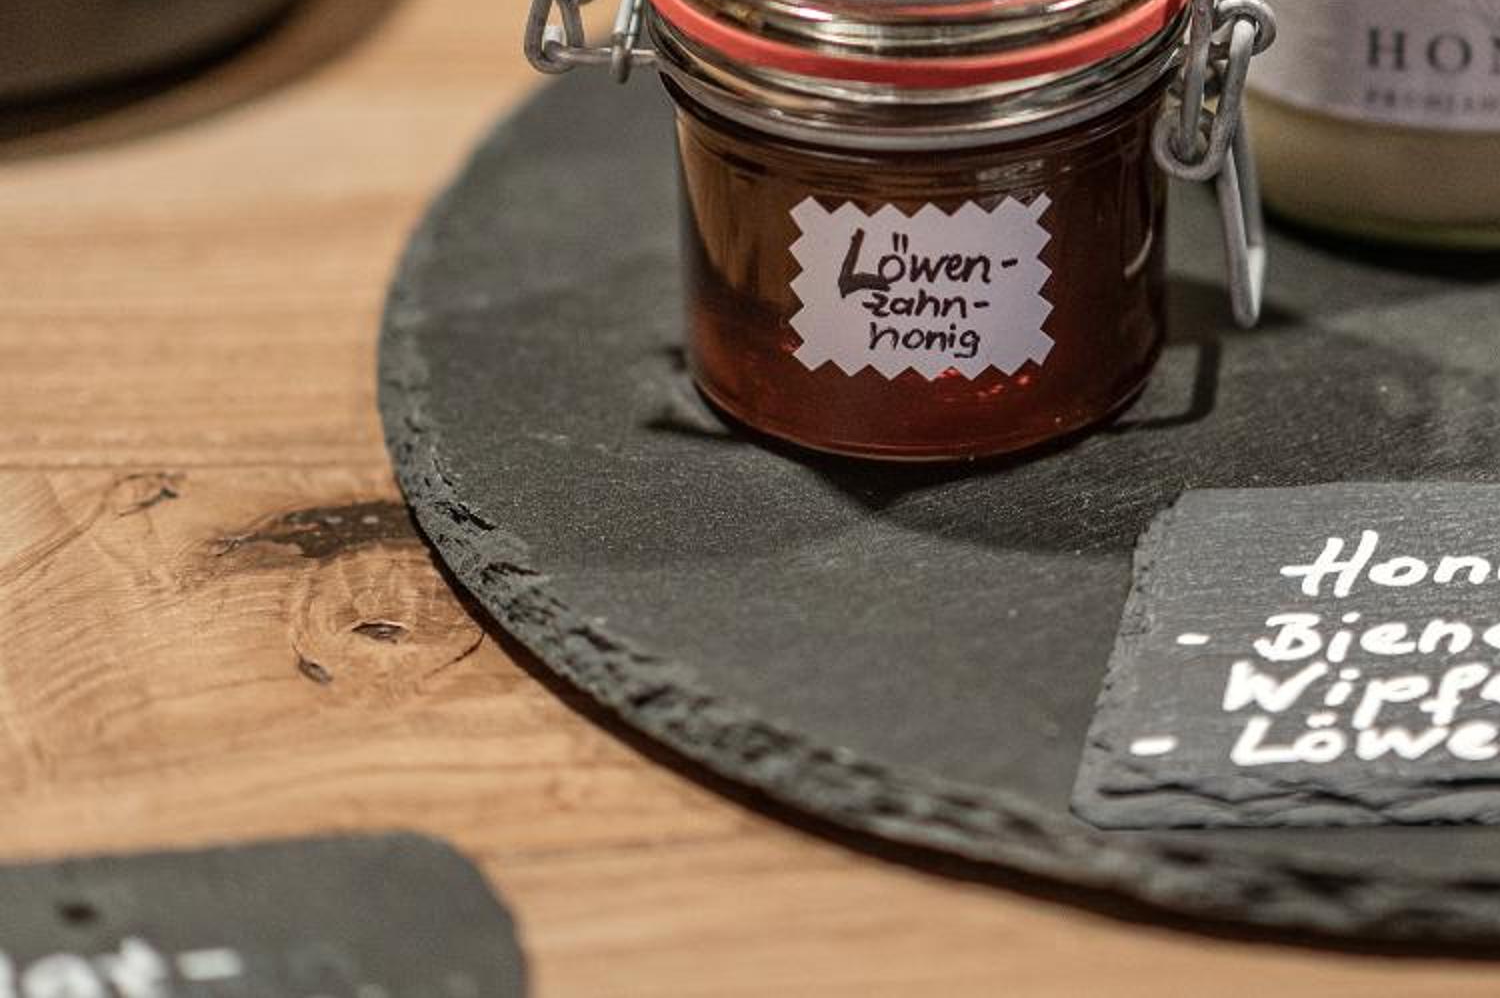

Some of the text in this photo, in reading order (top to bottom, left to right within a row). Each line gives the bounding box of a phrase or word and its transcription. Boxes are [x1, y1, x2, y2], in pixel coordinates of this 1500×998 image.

[837, 228, 1019, 299] Löwen-
[861, 288, 990, 319] zahn-
[868, 321, 981, 359] honig
